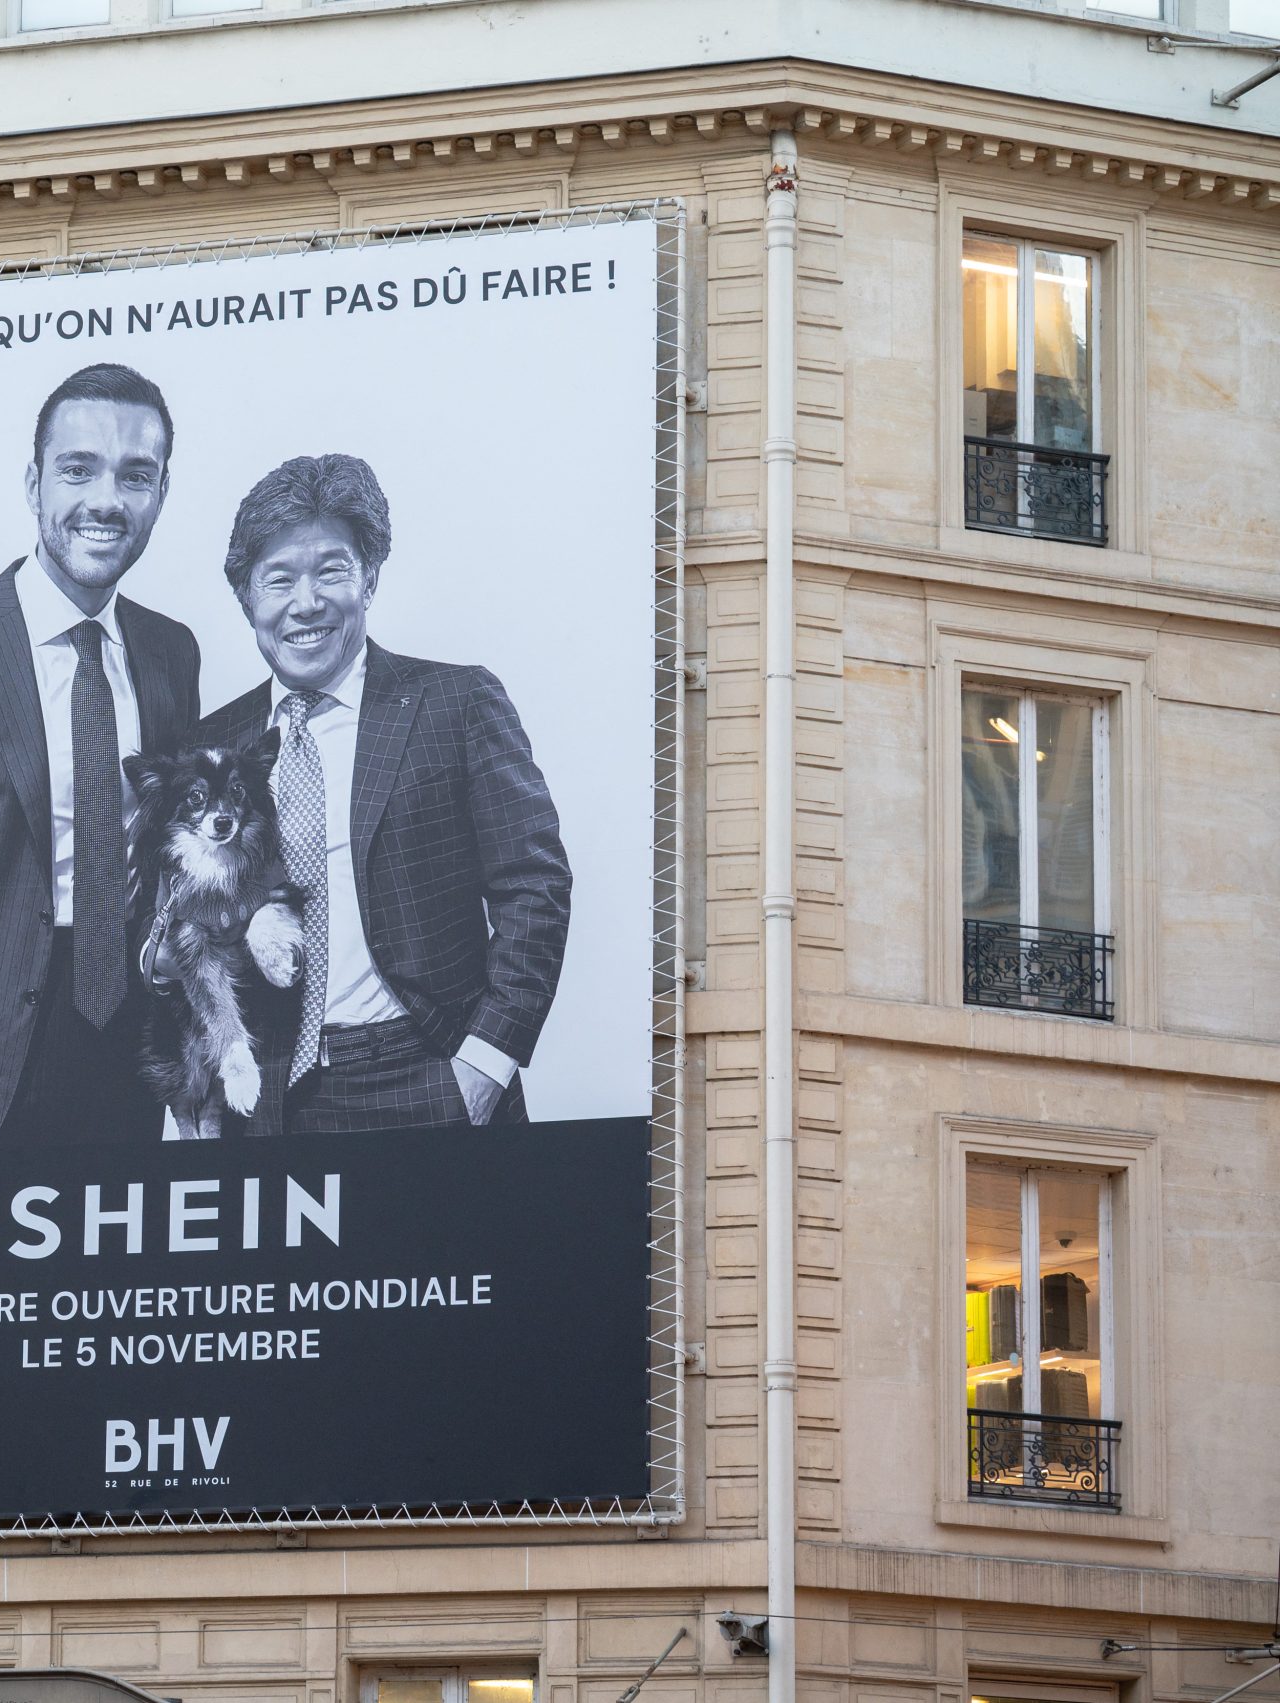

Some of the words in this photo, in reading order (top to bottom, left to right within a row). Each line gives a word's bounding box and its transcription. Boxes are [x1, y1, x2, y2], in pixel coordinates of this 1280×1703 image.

[127, 288, 312, 334] N’AURAIT
[325, 280, 398, 316] PAS
[413, 266, 467, 308] DÛ
[482, 261, 592, 302] FAIRE
[7, 1173, 341, 1260] SHEIN
[51, 1282, 275, 1321] OUVERTURE
[289, 1274, 492, 1312] MONDIALE
[22, 1337, 63, 1369] LE
[76, 1336, 97, 1367] 5
[110, 1328, 321, 1366] NOVEMBRE
[105, 1416, 231, 1473] BHV
[105, 1480, 118, 1488] 52
[130, 1479, 152, 1488] RUE
[164, 1478, 179, 1487] DE
[191, 1476, 230, 1486] RIVOLI
